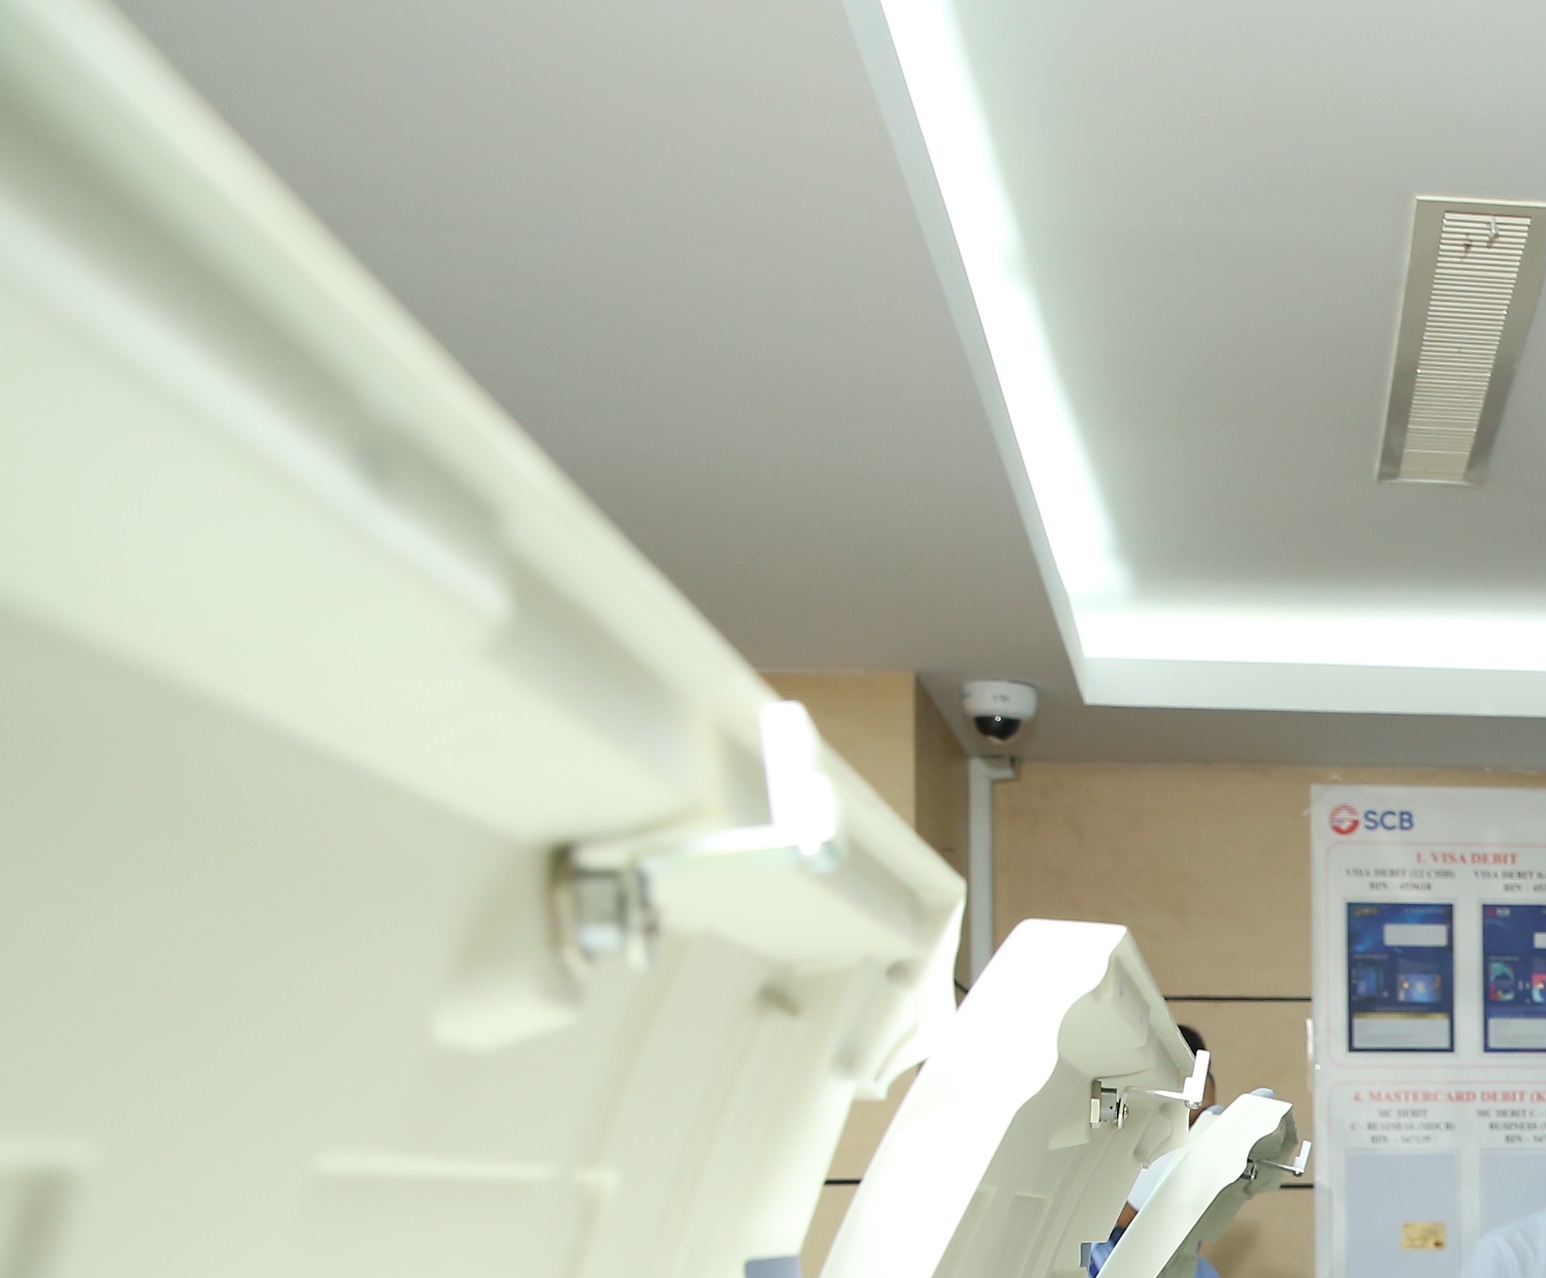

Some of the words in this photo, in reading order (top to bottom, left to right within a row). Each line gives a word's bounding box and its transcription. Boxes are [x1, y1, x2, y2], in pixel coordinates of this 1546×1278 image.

[1364, 809, 1414, 832] SCB
[1431, 852, 1467, 865] VISA
[1470, 852, 1518, 866] DEBIT
[1368, 1090, 1477, 1104] MASTERCARD
[1480, 1090, 1525, 1103] DEBIT
